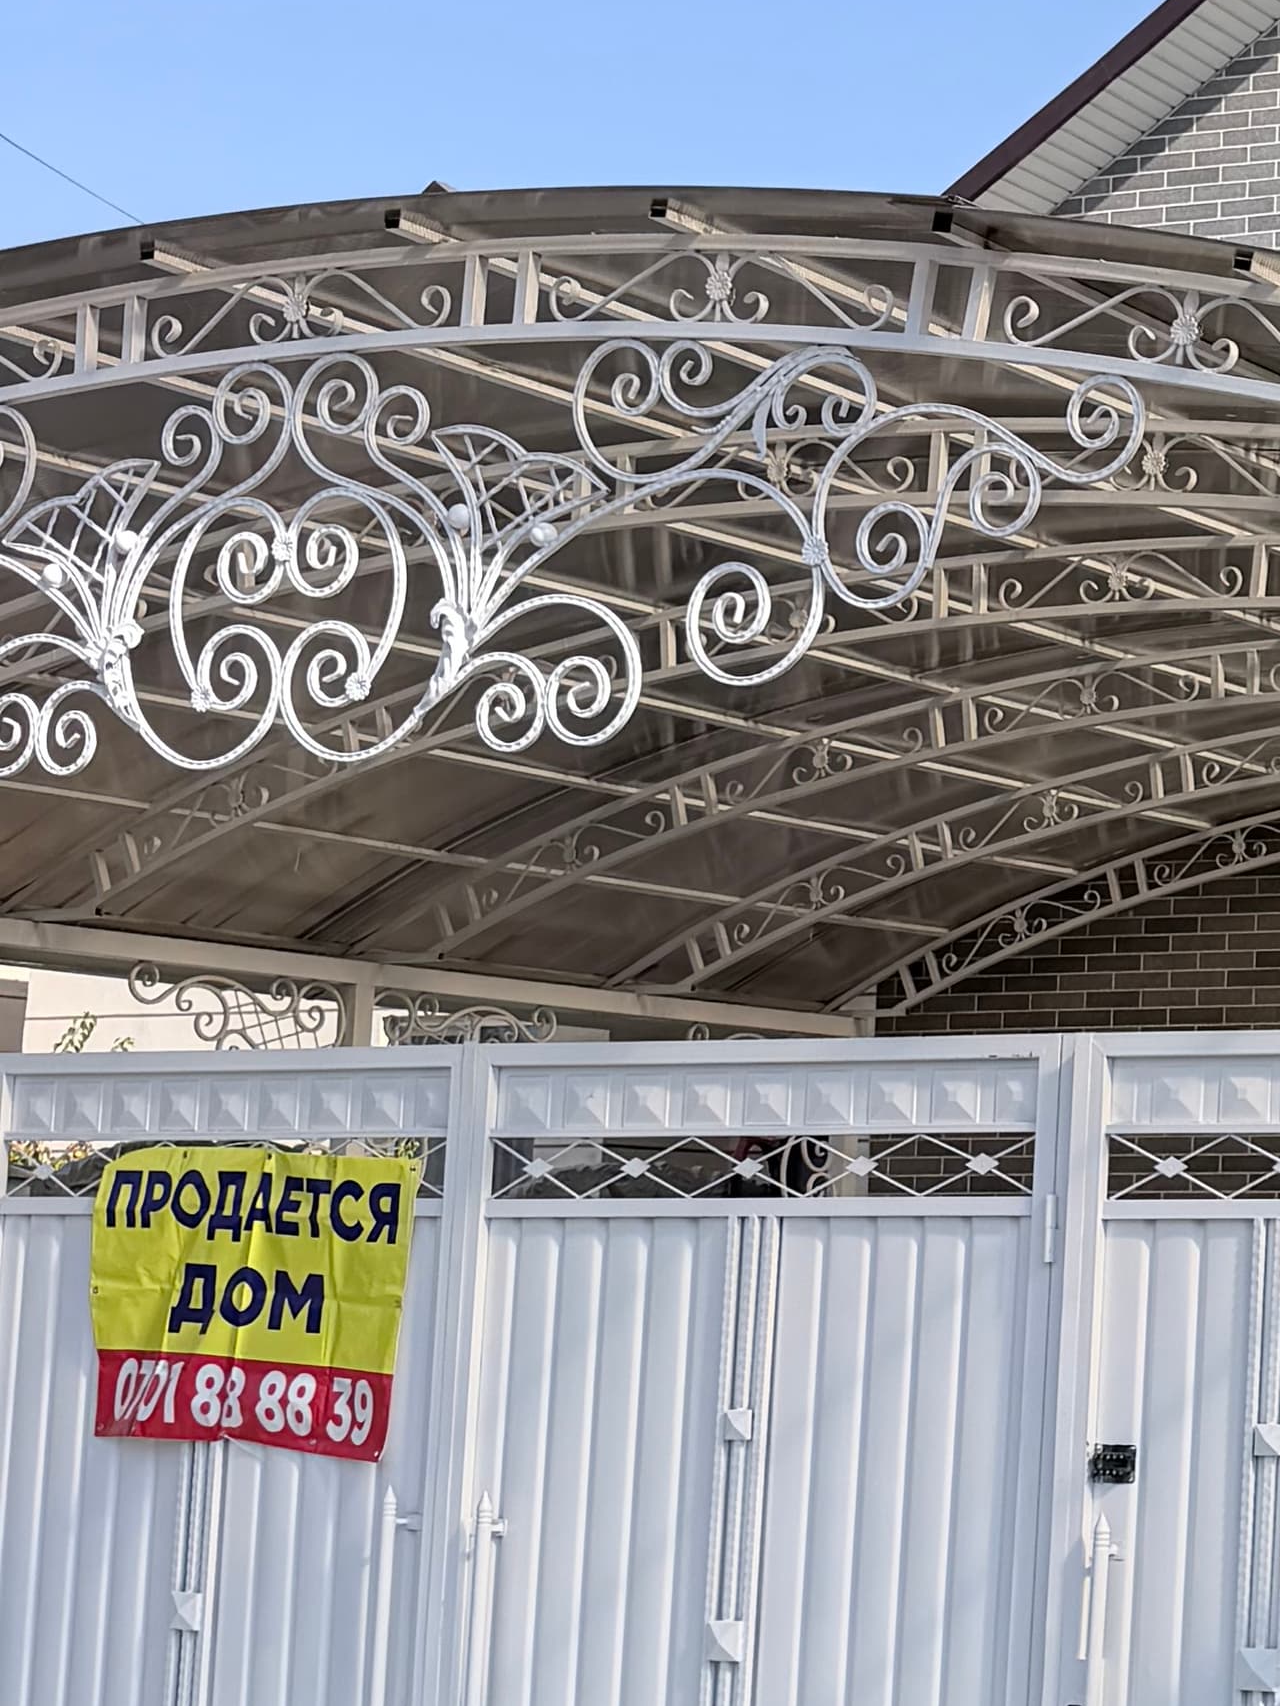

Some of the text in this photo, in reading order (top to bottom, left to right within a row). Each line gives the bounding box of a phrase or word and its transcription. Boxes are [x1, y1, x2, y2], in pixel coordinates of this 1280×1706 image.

[106, 1169, 401, 1244] ПРОДАЕТСЯ
[168, 1263, 325, 1335] ДОМ
[191, 1363, 246, 1428] 88
[255, 1369, 317, 1437] 88
[326, 1376, 374, 1446] 39
